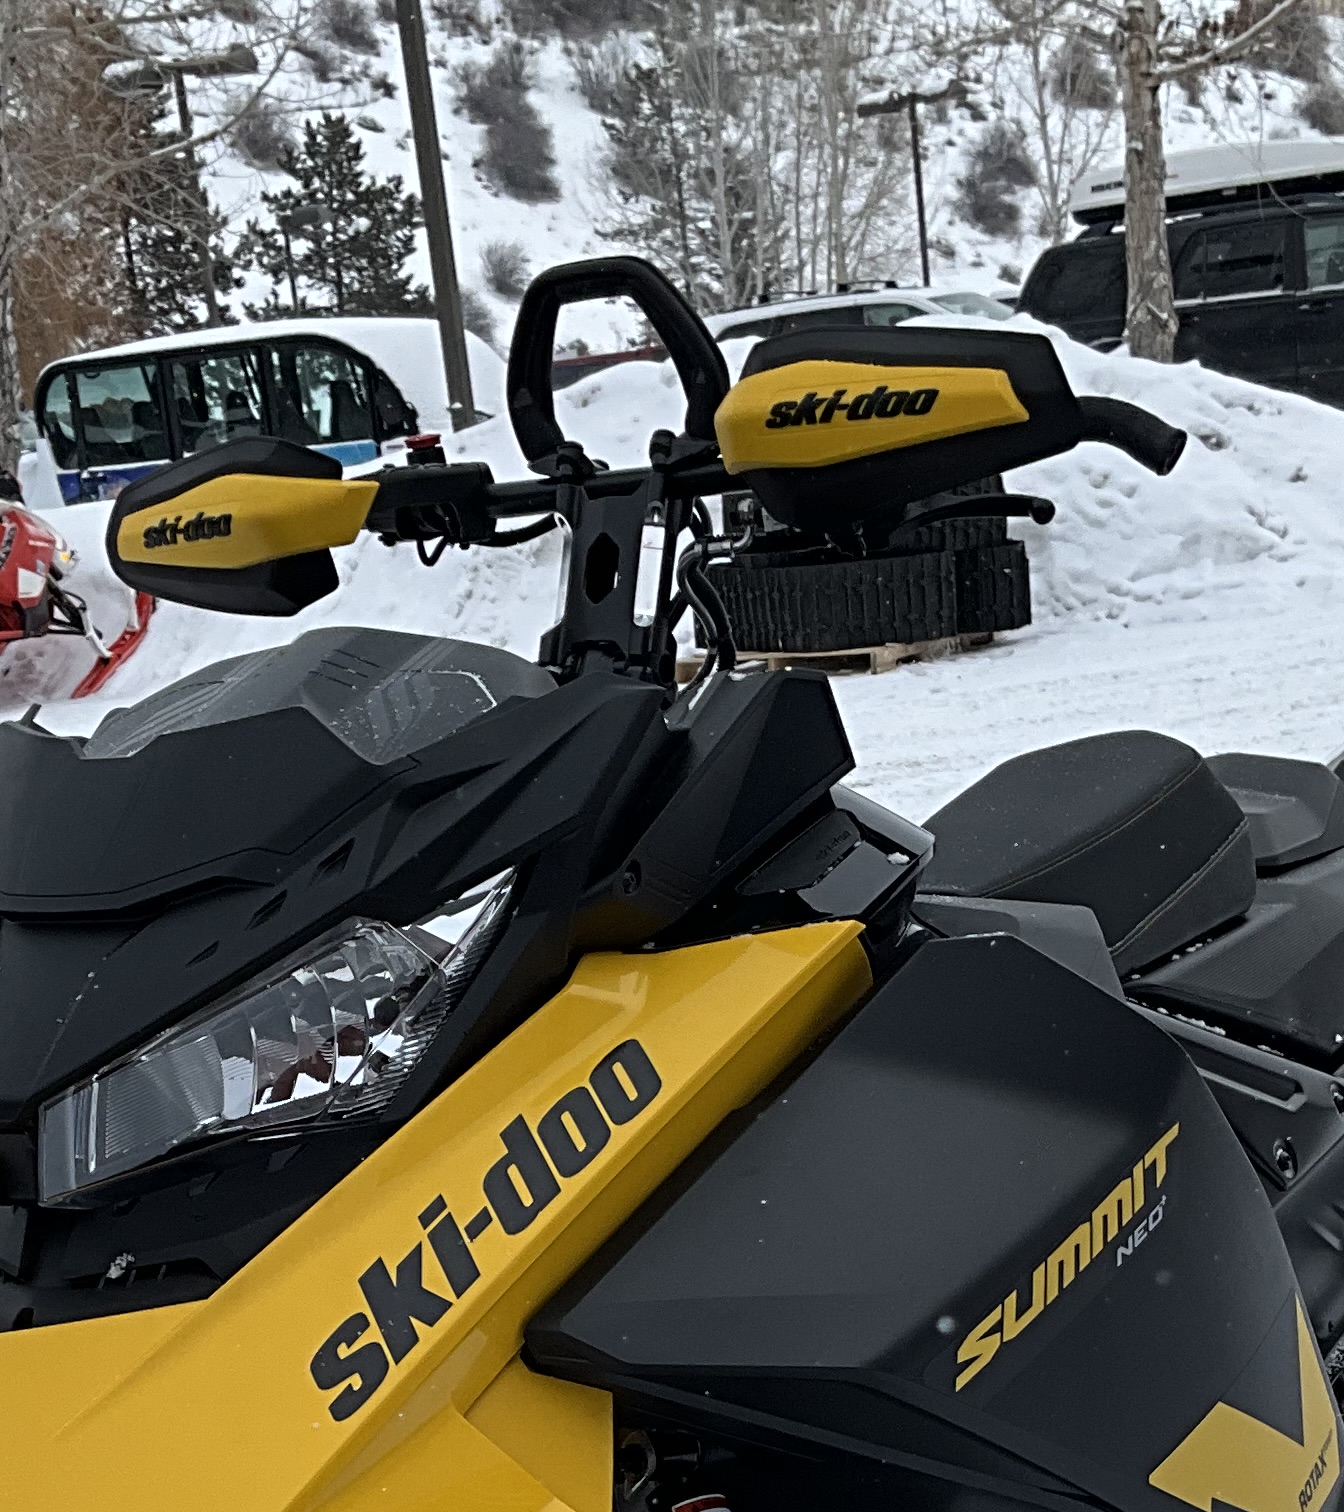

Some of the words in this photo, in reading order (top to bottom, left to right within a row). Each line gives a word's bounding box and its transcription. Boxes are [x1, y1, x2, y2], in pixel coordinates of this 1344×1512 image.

[765, 385, 939, 429] ski-doo
[143, 511, 232, 549] ski-doo
[310, 1038, 662, 1422] ski-doo
[955, 1121, 1180, 1392] SUMMIT
